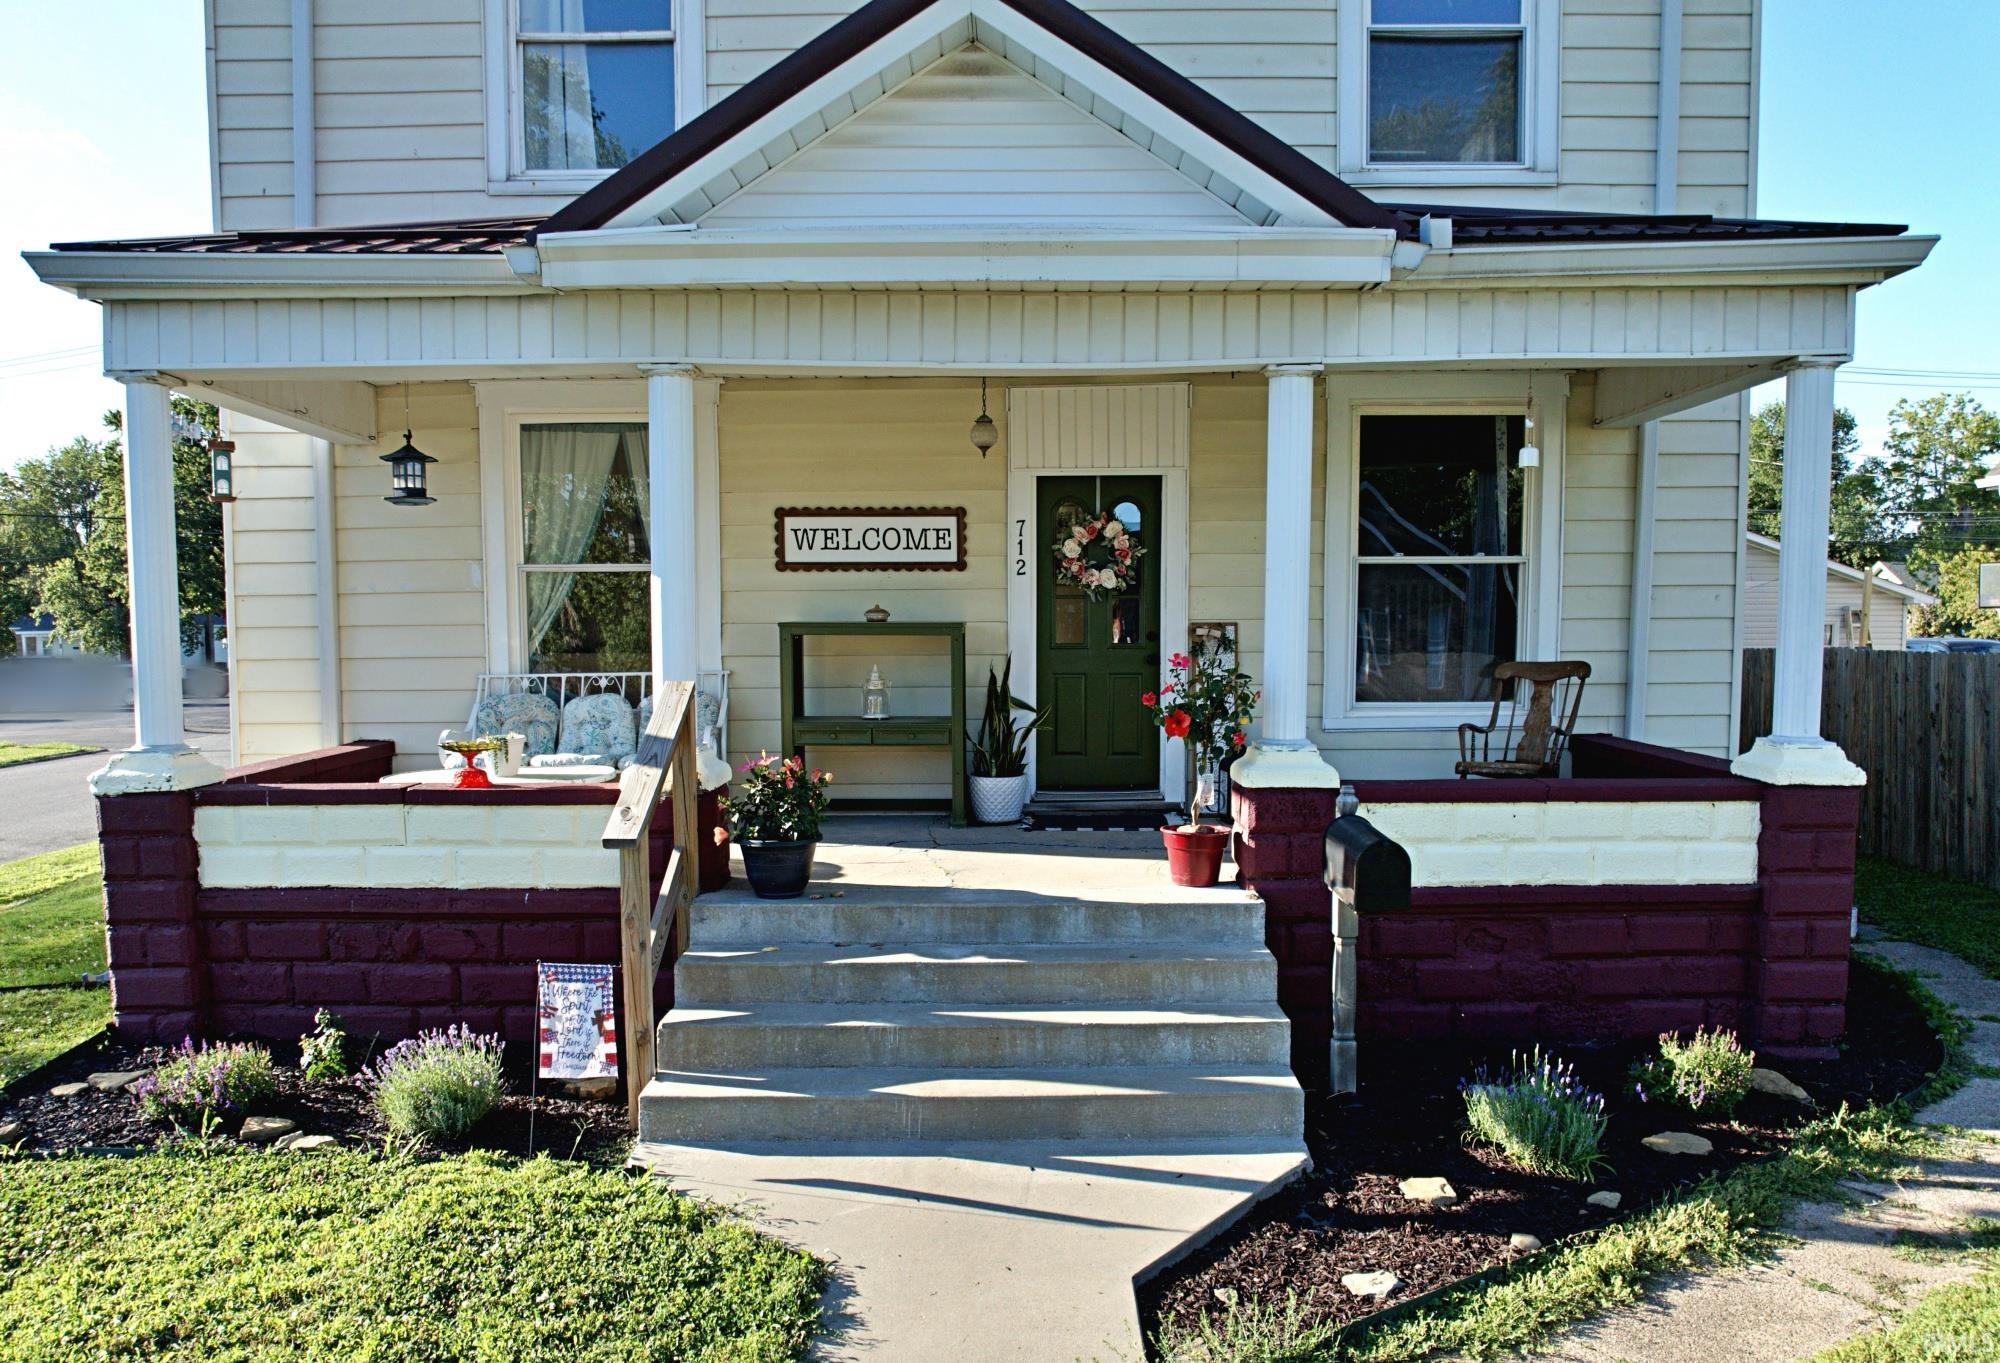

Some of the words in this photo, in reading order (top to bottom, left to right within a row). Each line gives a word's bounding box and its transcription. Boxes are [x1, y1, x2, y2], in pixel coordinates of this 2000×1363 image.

[790, 527, 952, 551] WELCOME
[1015, 519, 1027, 576] 712
[552, 984, 582, 998] Where
[584, 984, 598, 998] the
[561, 997, 592, 1014] Spirit
[565, 1016, 576, 1026] of
[576, 1015, 587, 1025] the
[560, 1022, 584, 1036] Lord
[557, 1046, 598, 1061] Freedom
